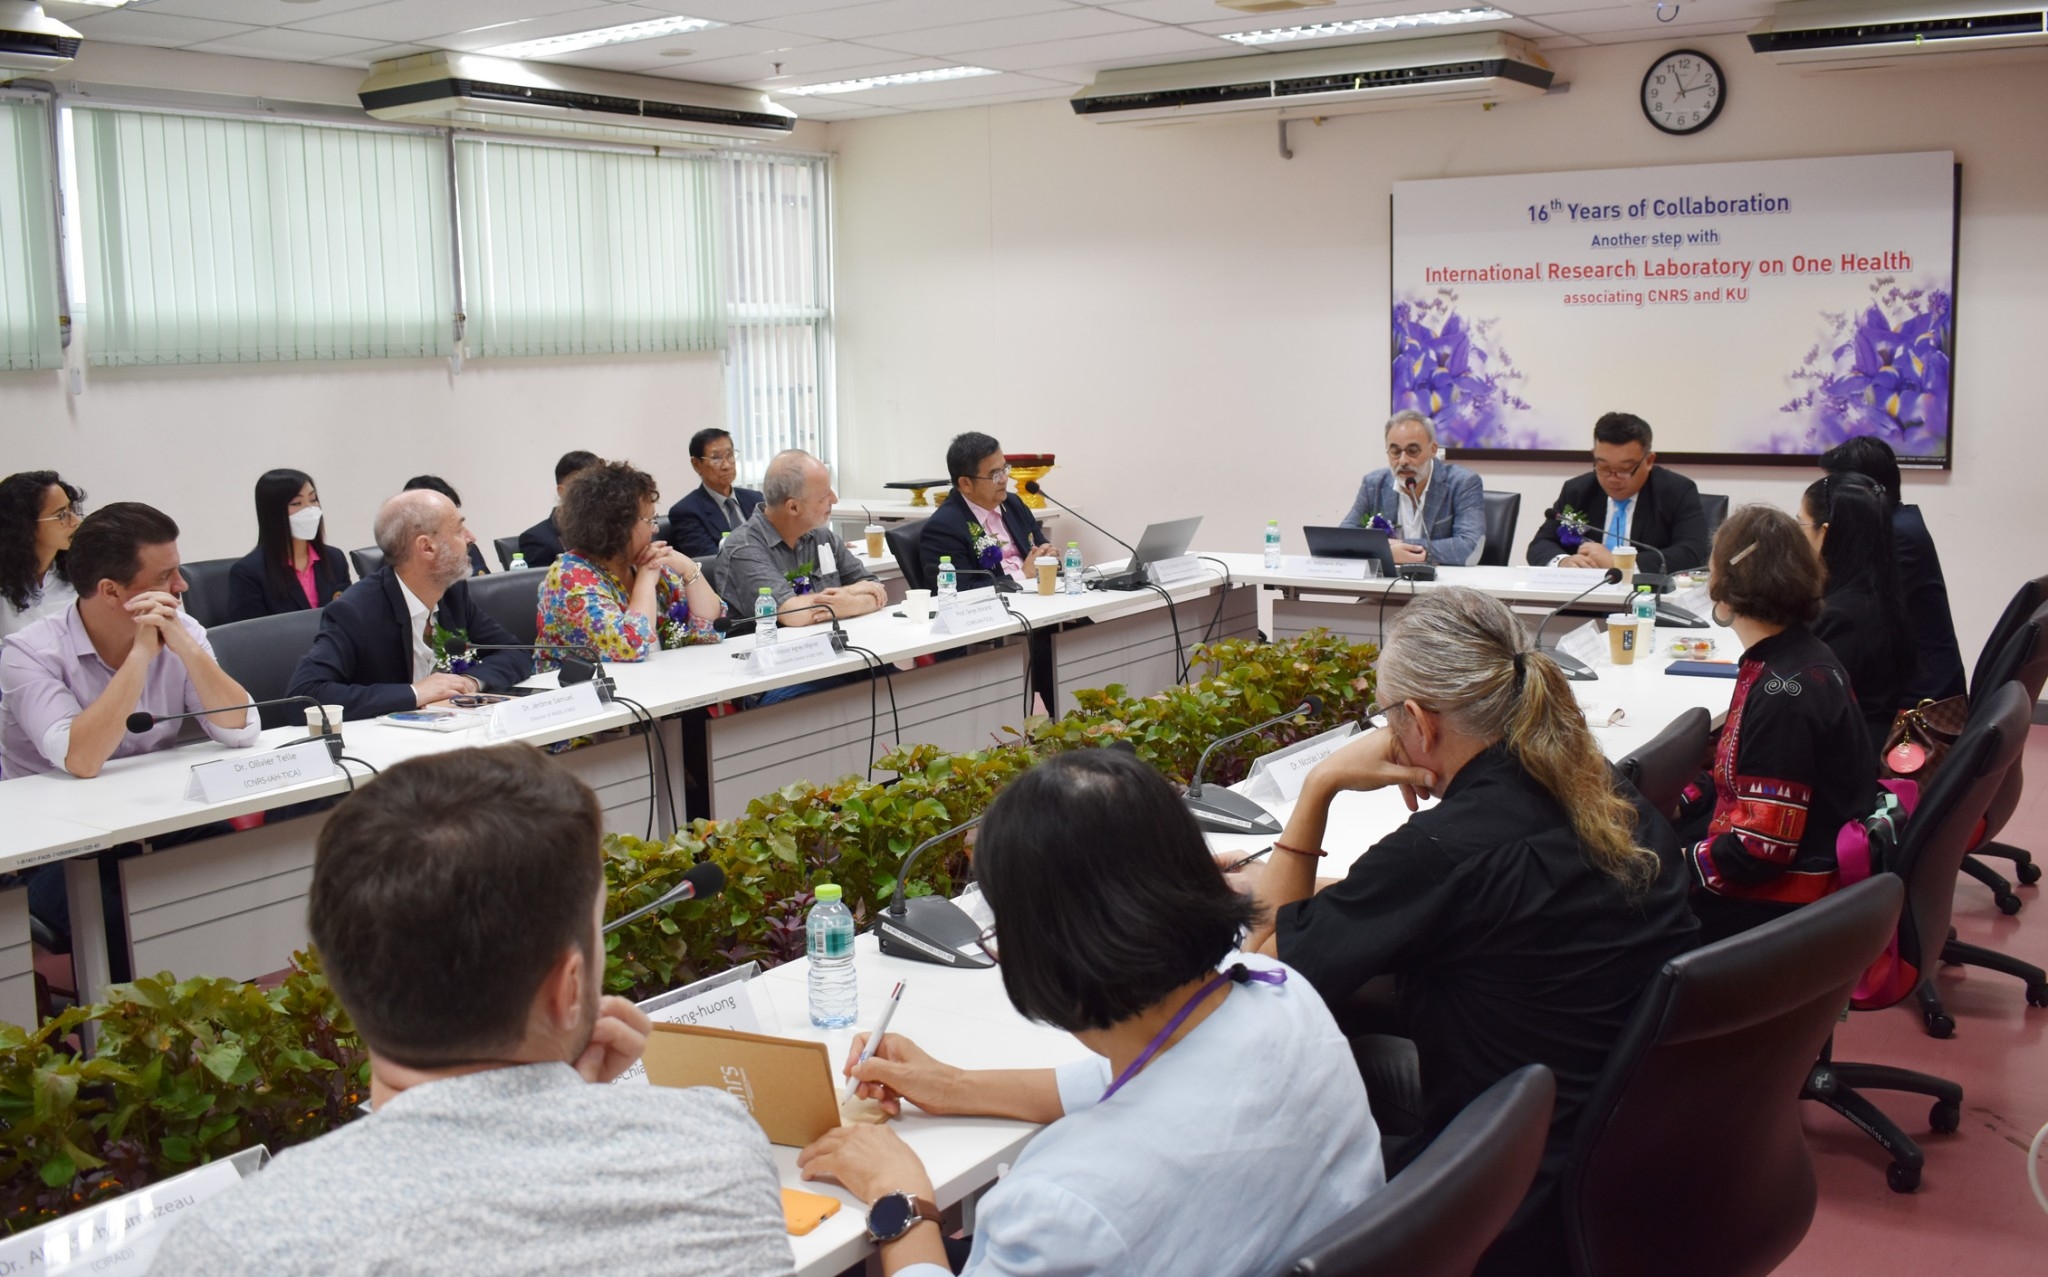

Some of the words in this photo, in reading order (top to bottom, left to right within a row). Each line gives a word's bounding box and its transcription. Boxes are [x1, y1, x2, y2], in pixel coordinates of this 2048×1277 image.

[1667, 64, 1675, 73] 11
[1679, 59, 1690, 69] 12
[1696, 63, 1701, 72] 1
[1656, 75, 1666, 85] 10
[1704, 73, 1713, 83] 2
[1651, 88, 1659, 98] 9
[1708, 87, 1716, 97] 3
[1655, 102, 1662, 111] 8
[1703, 101, 1711, 109] 4
[1664, 112, 1672, 121] 7
[1677, 115, 1685, 126] 6
[1692, 111, 1700, 121] 5
[1528, 199, 1562, 222] 16th
[1567, 202, 1621, 220] Years
[1628, 199, 1647, 217] of
[1653, 193, 1789, 216] Collaboration
[1591, 232, 1647, 247] Another
[1652, 232, 1682, 248] step
[1687, 229, 1719, 244] with
[1426, 263, 1541, 283] International
[1549, 260, 1636, 279] Research
[1644, 258, 1751, 280] Laboratory
[1759, 259, 1784, 274] on
[1792, 255, 1833, 273] One
[1841, 251, 1911, 271] Health
[1563, 289, 1643, 306] associating
[1648, 289, 1689, 302] CNRS
[1693, 288, 1720, 302] and
[1726, 288, 1747, 301] KU
[234, 762, 247, 773] Dr.
[276, 752, 297, 764] Telle
